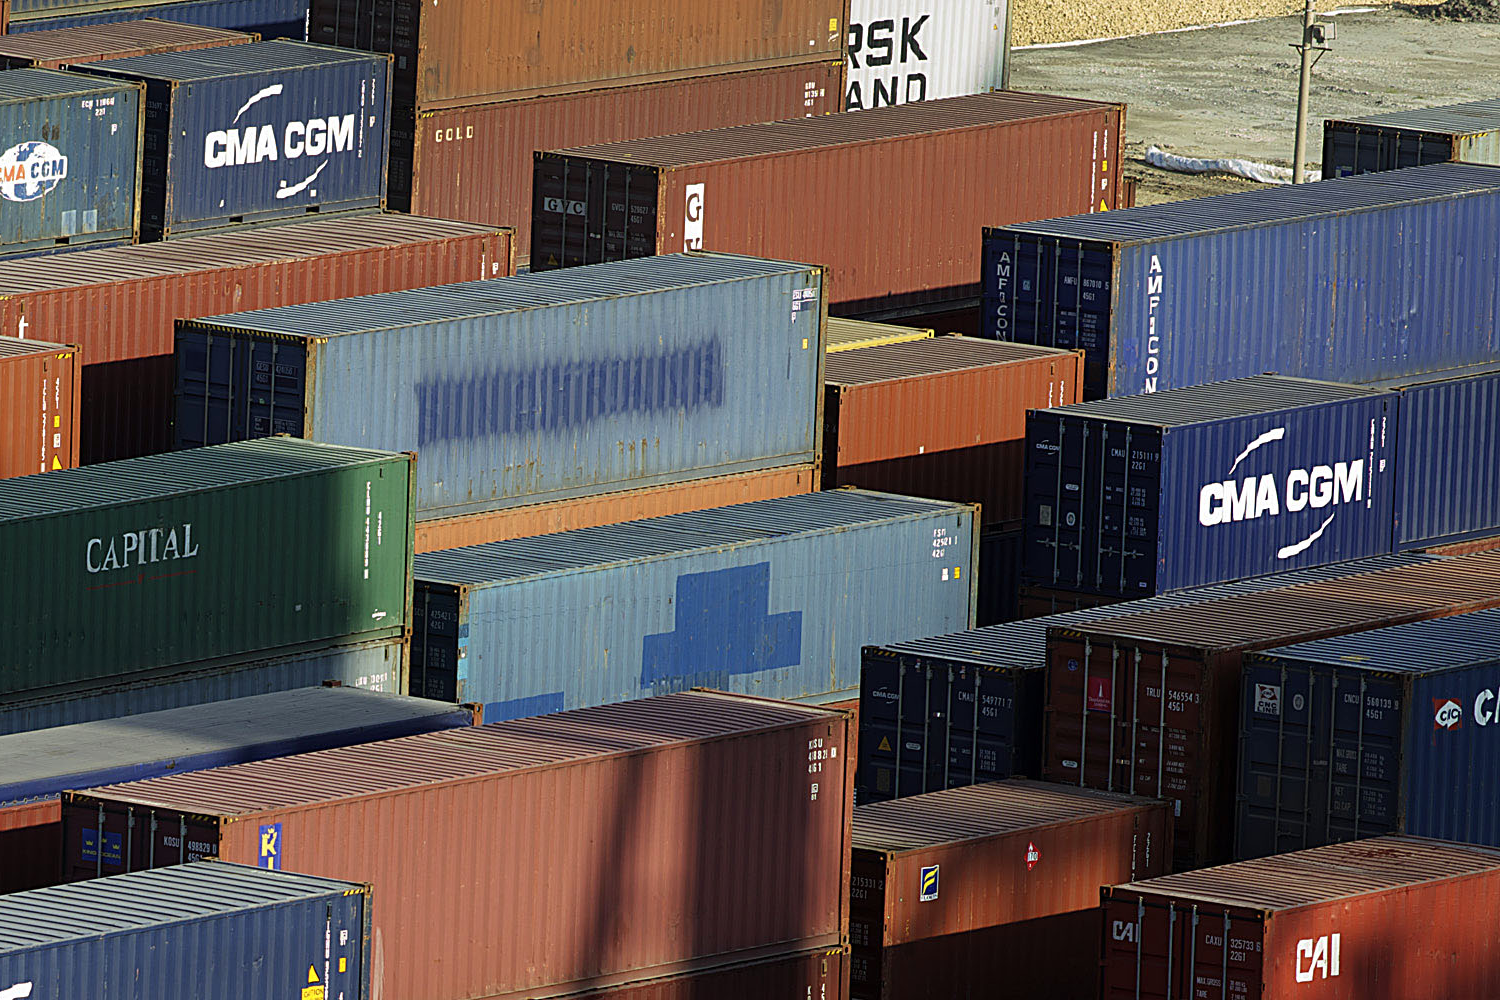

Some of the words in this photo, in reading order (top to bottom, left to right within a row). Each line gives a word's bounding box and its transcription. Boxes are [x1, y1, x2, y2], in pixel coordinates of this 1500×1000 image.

[204, 124, 278, 169] CMA
[283, 114, 355, 159] CGM
[435, 125, 475, 142] GOLD
[31, 157, 66, 178] CGM
[547, 198, 584, 215] GVC
[994, 251, 1011, 342] AMFICON
[1144, 254, 1164, 394] AMFICON
[1199, 473, 1279, 527] CMA
[1286, 460, 1363, 512] CGM
[85, 524, 199, 574] CAPITAL
[1146, 686, 1161, 699] TRLU
[1344, 693, 1359, 705] CNCU
[1167, 701, 1185, 713] 45G1
[1257, 700, 1278, 709] CNC
[1366, 707, 1383, 719] 45G1
[163, 836, 179, 848] KOSU
[1113, 921, 1139, 944] CAI
[1205, 935, 1222, 948] CAXU
[1230, 938, 1254, 952] 325733
[1230, 950, 1246, 963] 22G1
[1296, 933, 1341, 983] CAI
